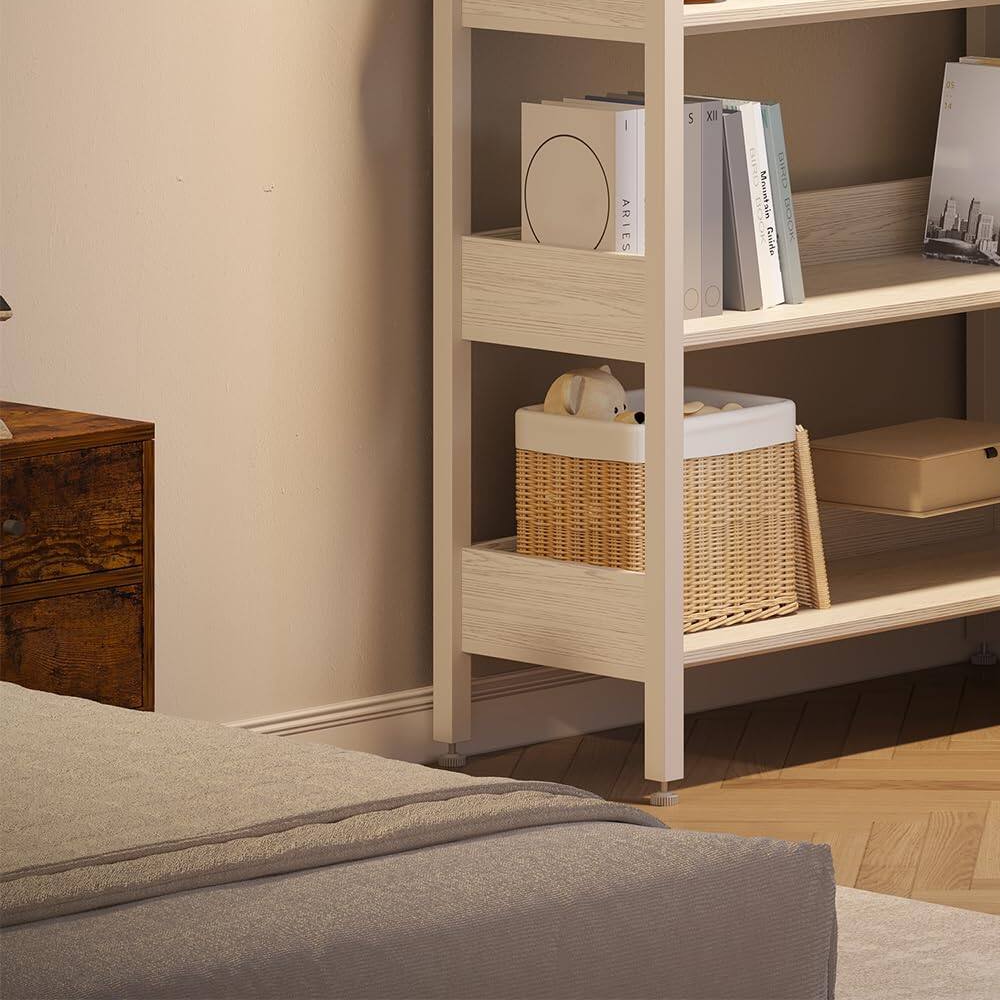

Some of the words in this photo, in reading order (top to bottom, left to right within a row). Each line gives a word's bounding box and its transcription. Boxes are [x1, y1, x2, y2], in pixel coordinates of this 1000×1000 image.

[706, 110, 718, 122] XII
[760, 170, 771, 220] Mountain
[778, 152, 788, 189] BIRD
[784, 197, 796, 242] BOOK
[622, 199, 631, 252] ARIES
